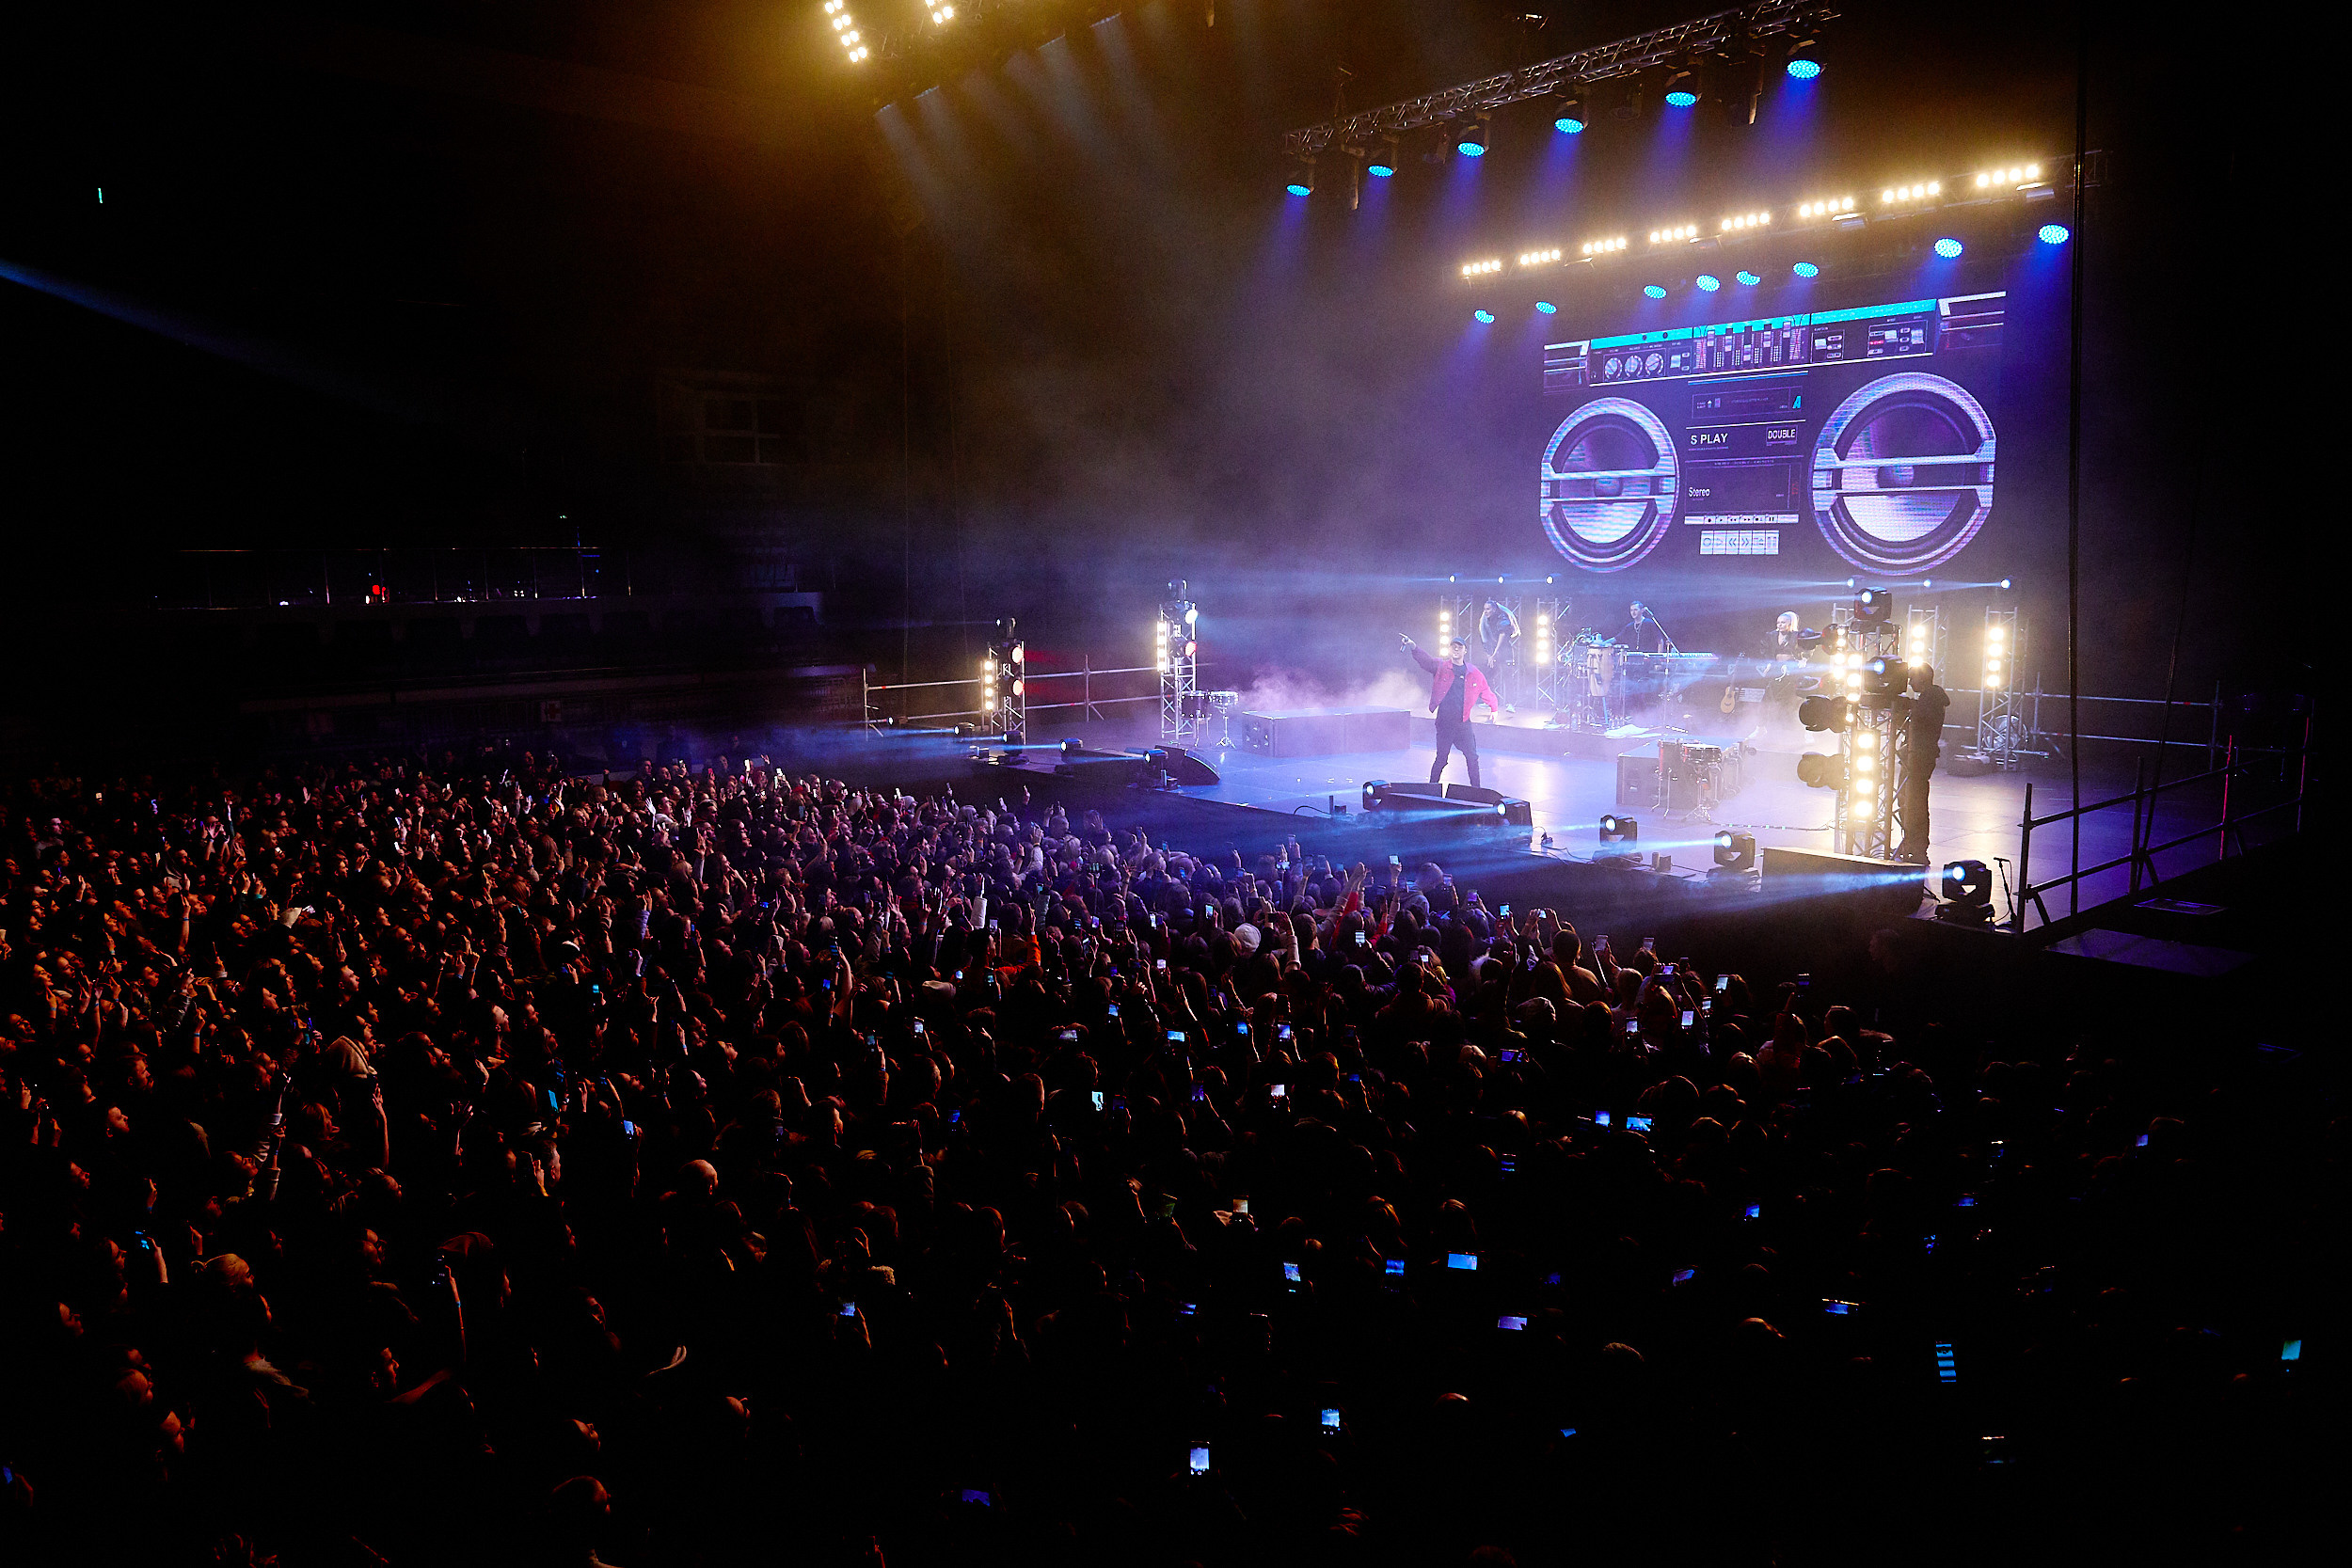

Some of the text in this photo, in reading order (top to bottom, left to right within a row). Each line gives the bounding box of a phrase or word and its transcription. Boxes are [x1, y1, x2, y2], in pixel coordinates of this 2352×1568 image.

[1792, 396, 1802, 409] A
[1691, 433, 1728, 445] S PLAY
[1768, 429, 1796, 439] DOUBLE
[1689, 486, 1710, 497] Stereo
